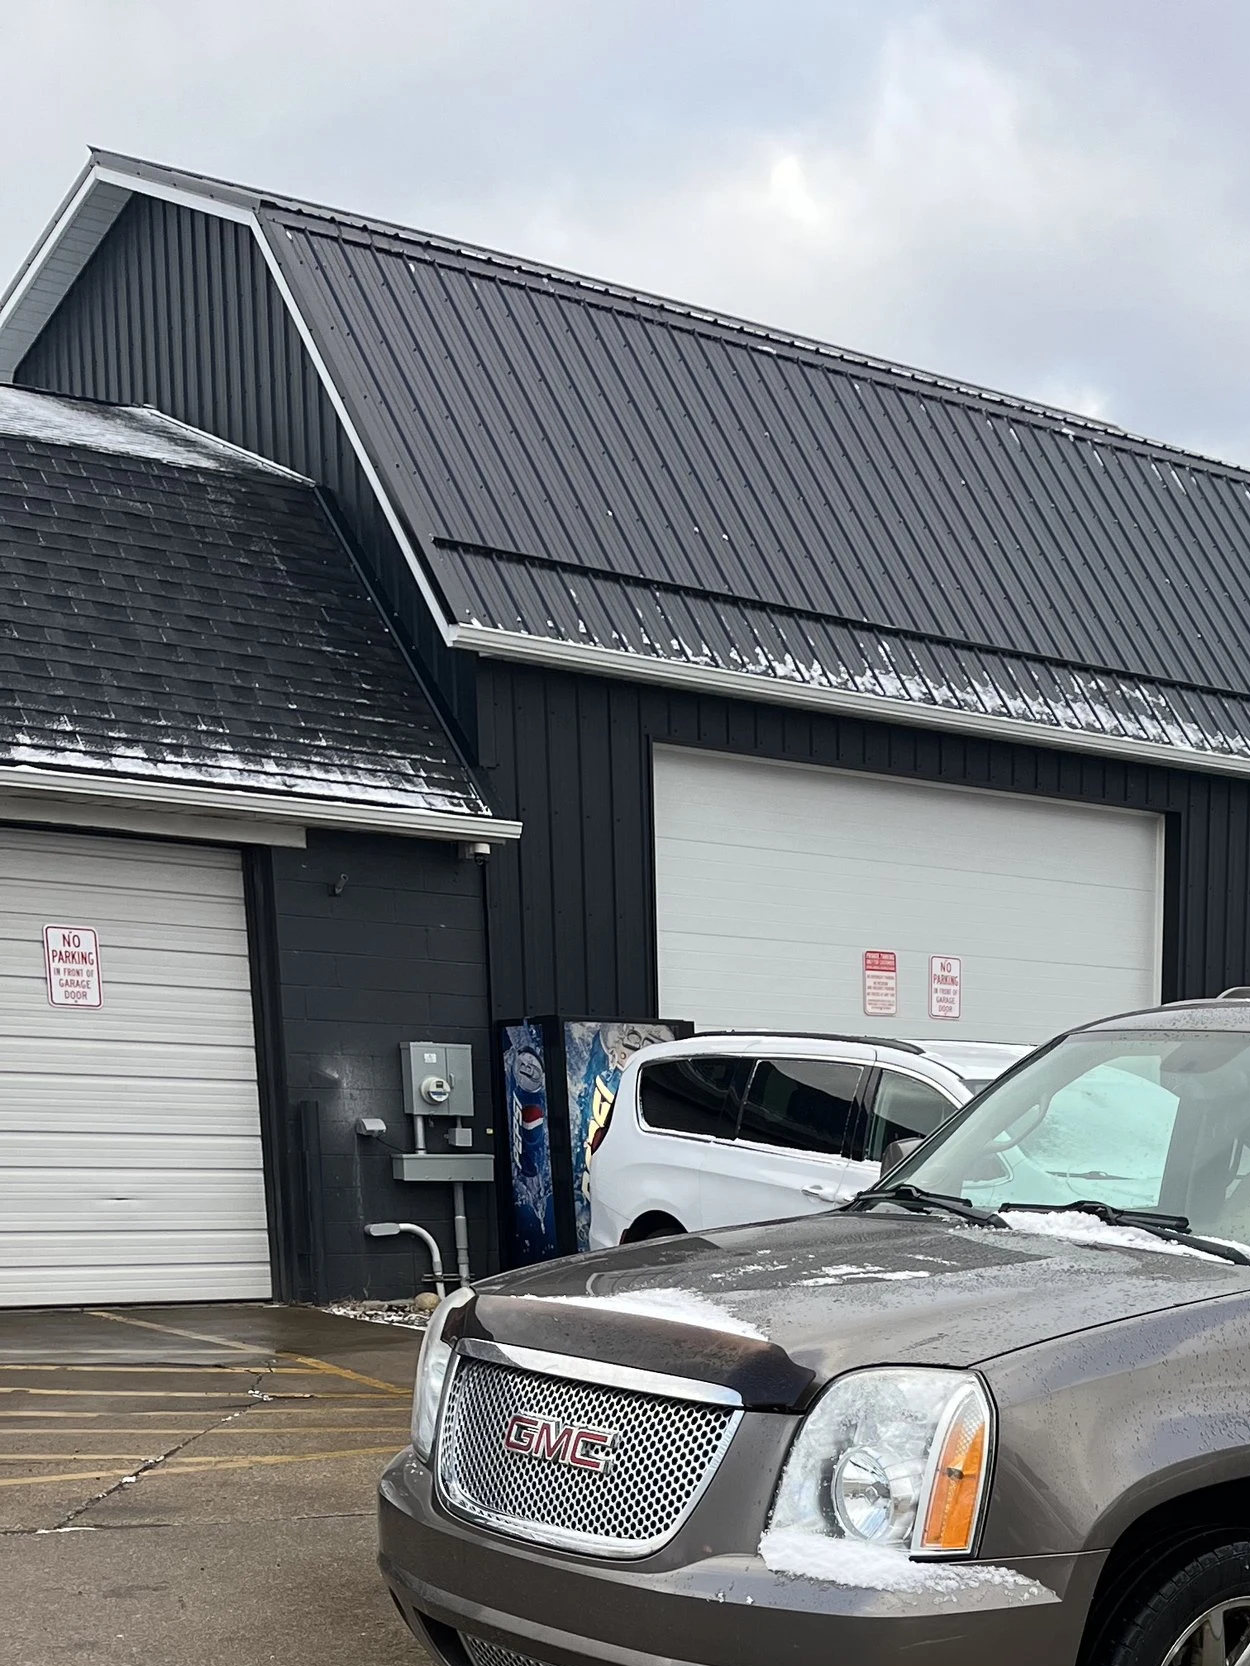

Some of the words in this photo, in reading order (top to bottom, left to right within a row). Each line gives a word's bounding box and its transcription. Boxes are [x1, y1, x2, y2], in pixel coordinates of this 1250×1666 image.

[62, 934, 81, 948] NO
[51, 949, 94, 966] PARKING
[53, 967, 61, 976] IN
[63, 968, 83, 977] FRONT
[86, 969, 94, 978] OF
[940, 961, 952, 973] NO
[58, 978, 92, 989] GARAGE
[933, 973, 959, 987] PARKING
[64, 990, 88, 1000] DOOR
[936, 996, 956, 1004] GARAGE
[504, 1413, 614, 1473] GMC
